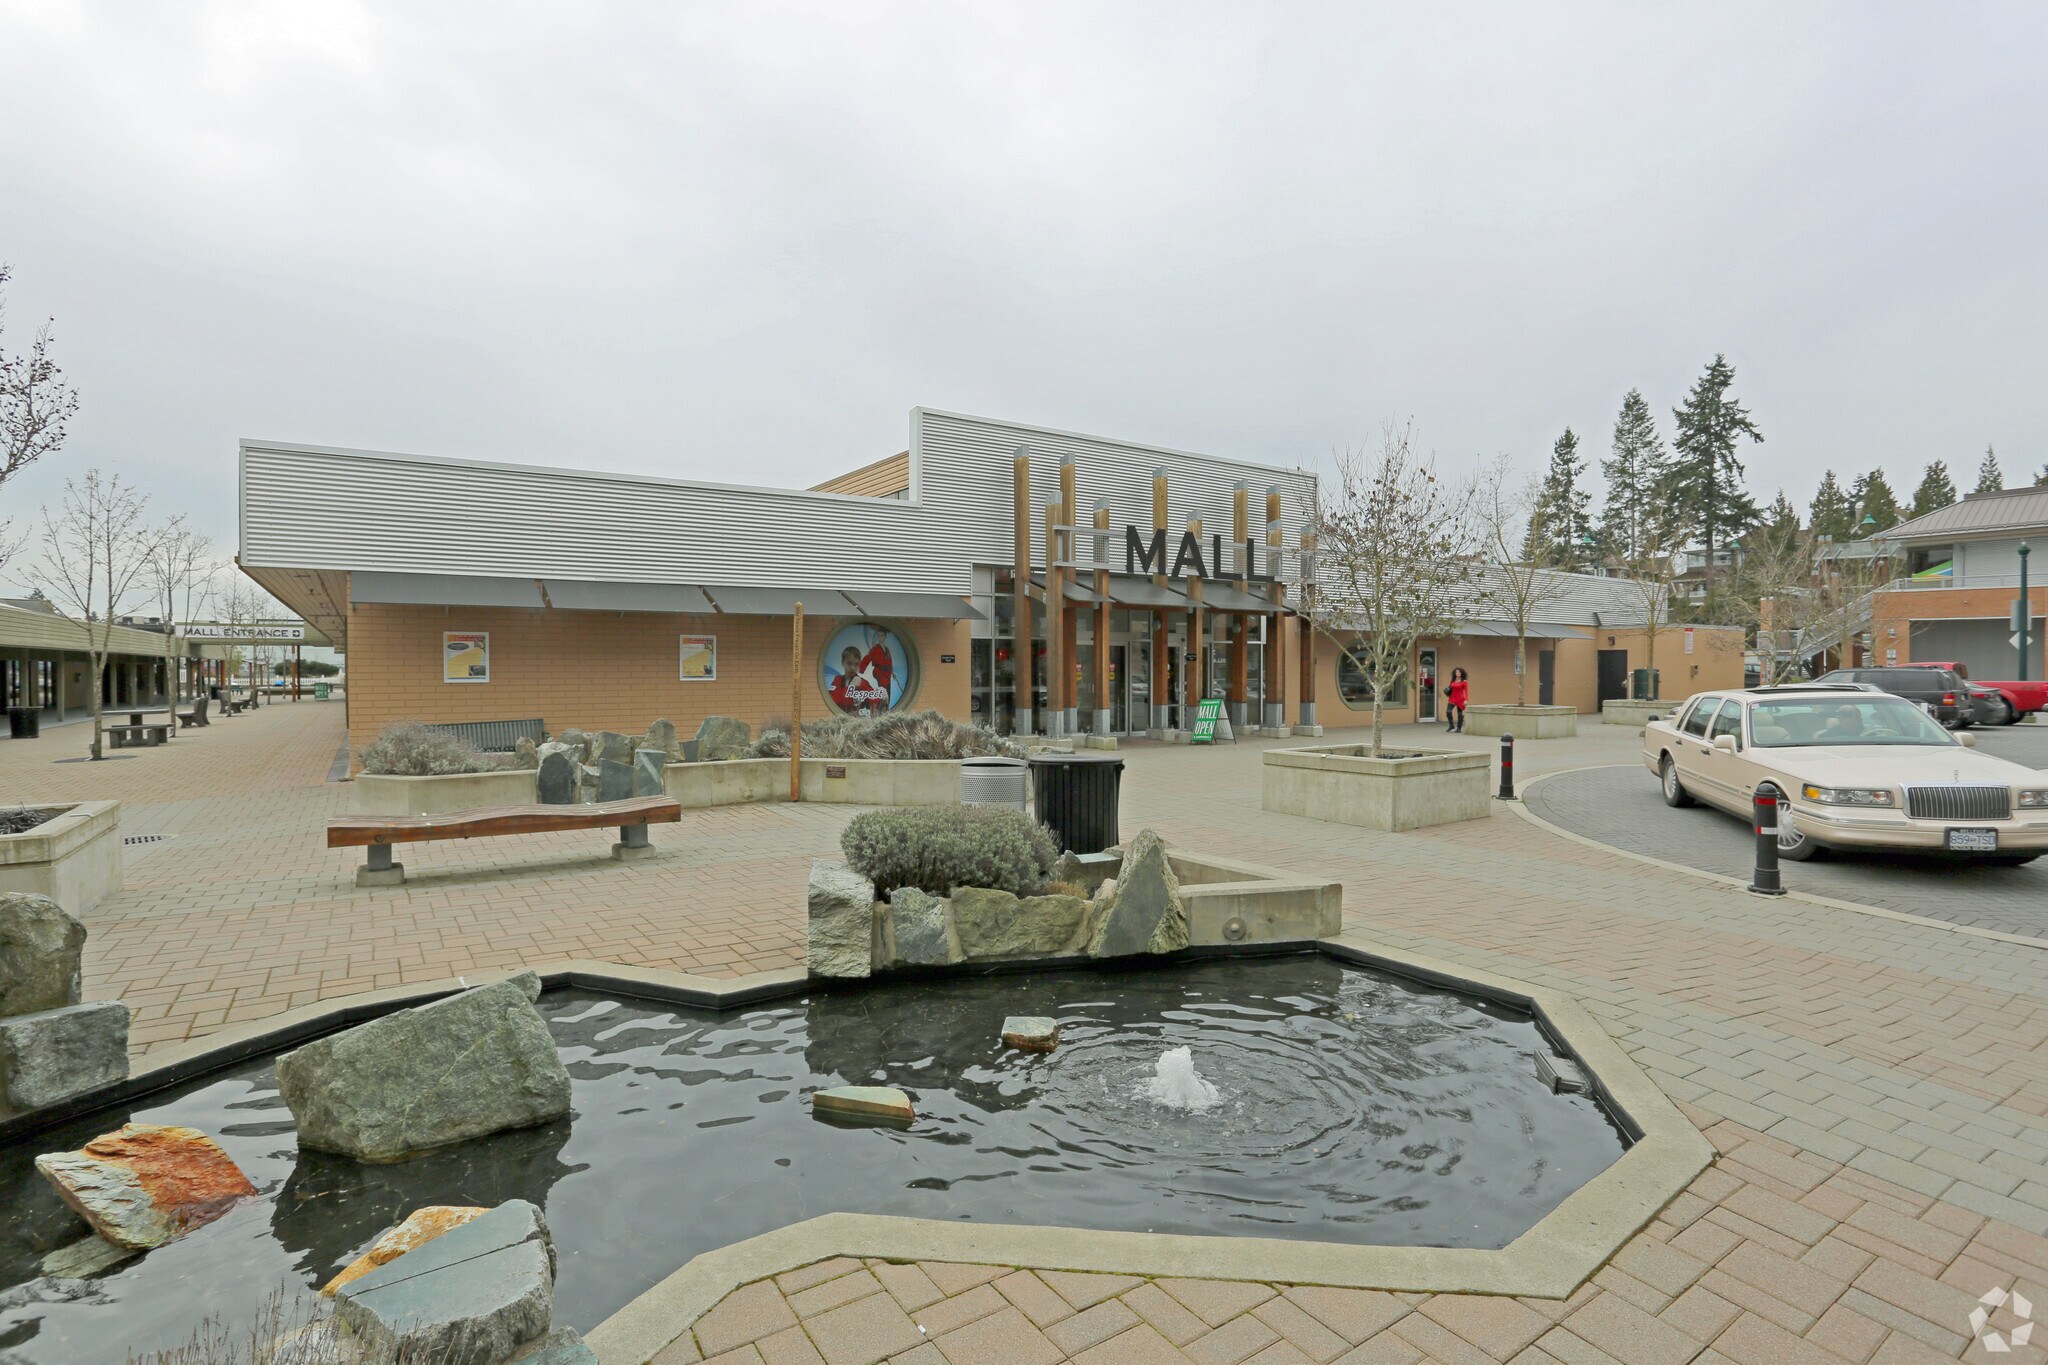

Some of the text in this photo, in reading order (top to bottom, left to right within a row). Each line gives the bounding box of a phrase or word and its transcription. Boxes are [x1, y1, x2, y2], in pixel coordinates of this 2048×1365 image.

[1126, 525, 1275, 582] MALL
[184, 628, 289, 638] MALL ENTRANCE
[846, 685, 883, 701] Respect
[1198, 705, 1218, 718] MALL
[1194, 720, 1215, 735] OPEN
